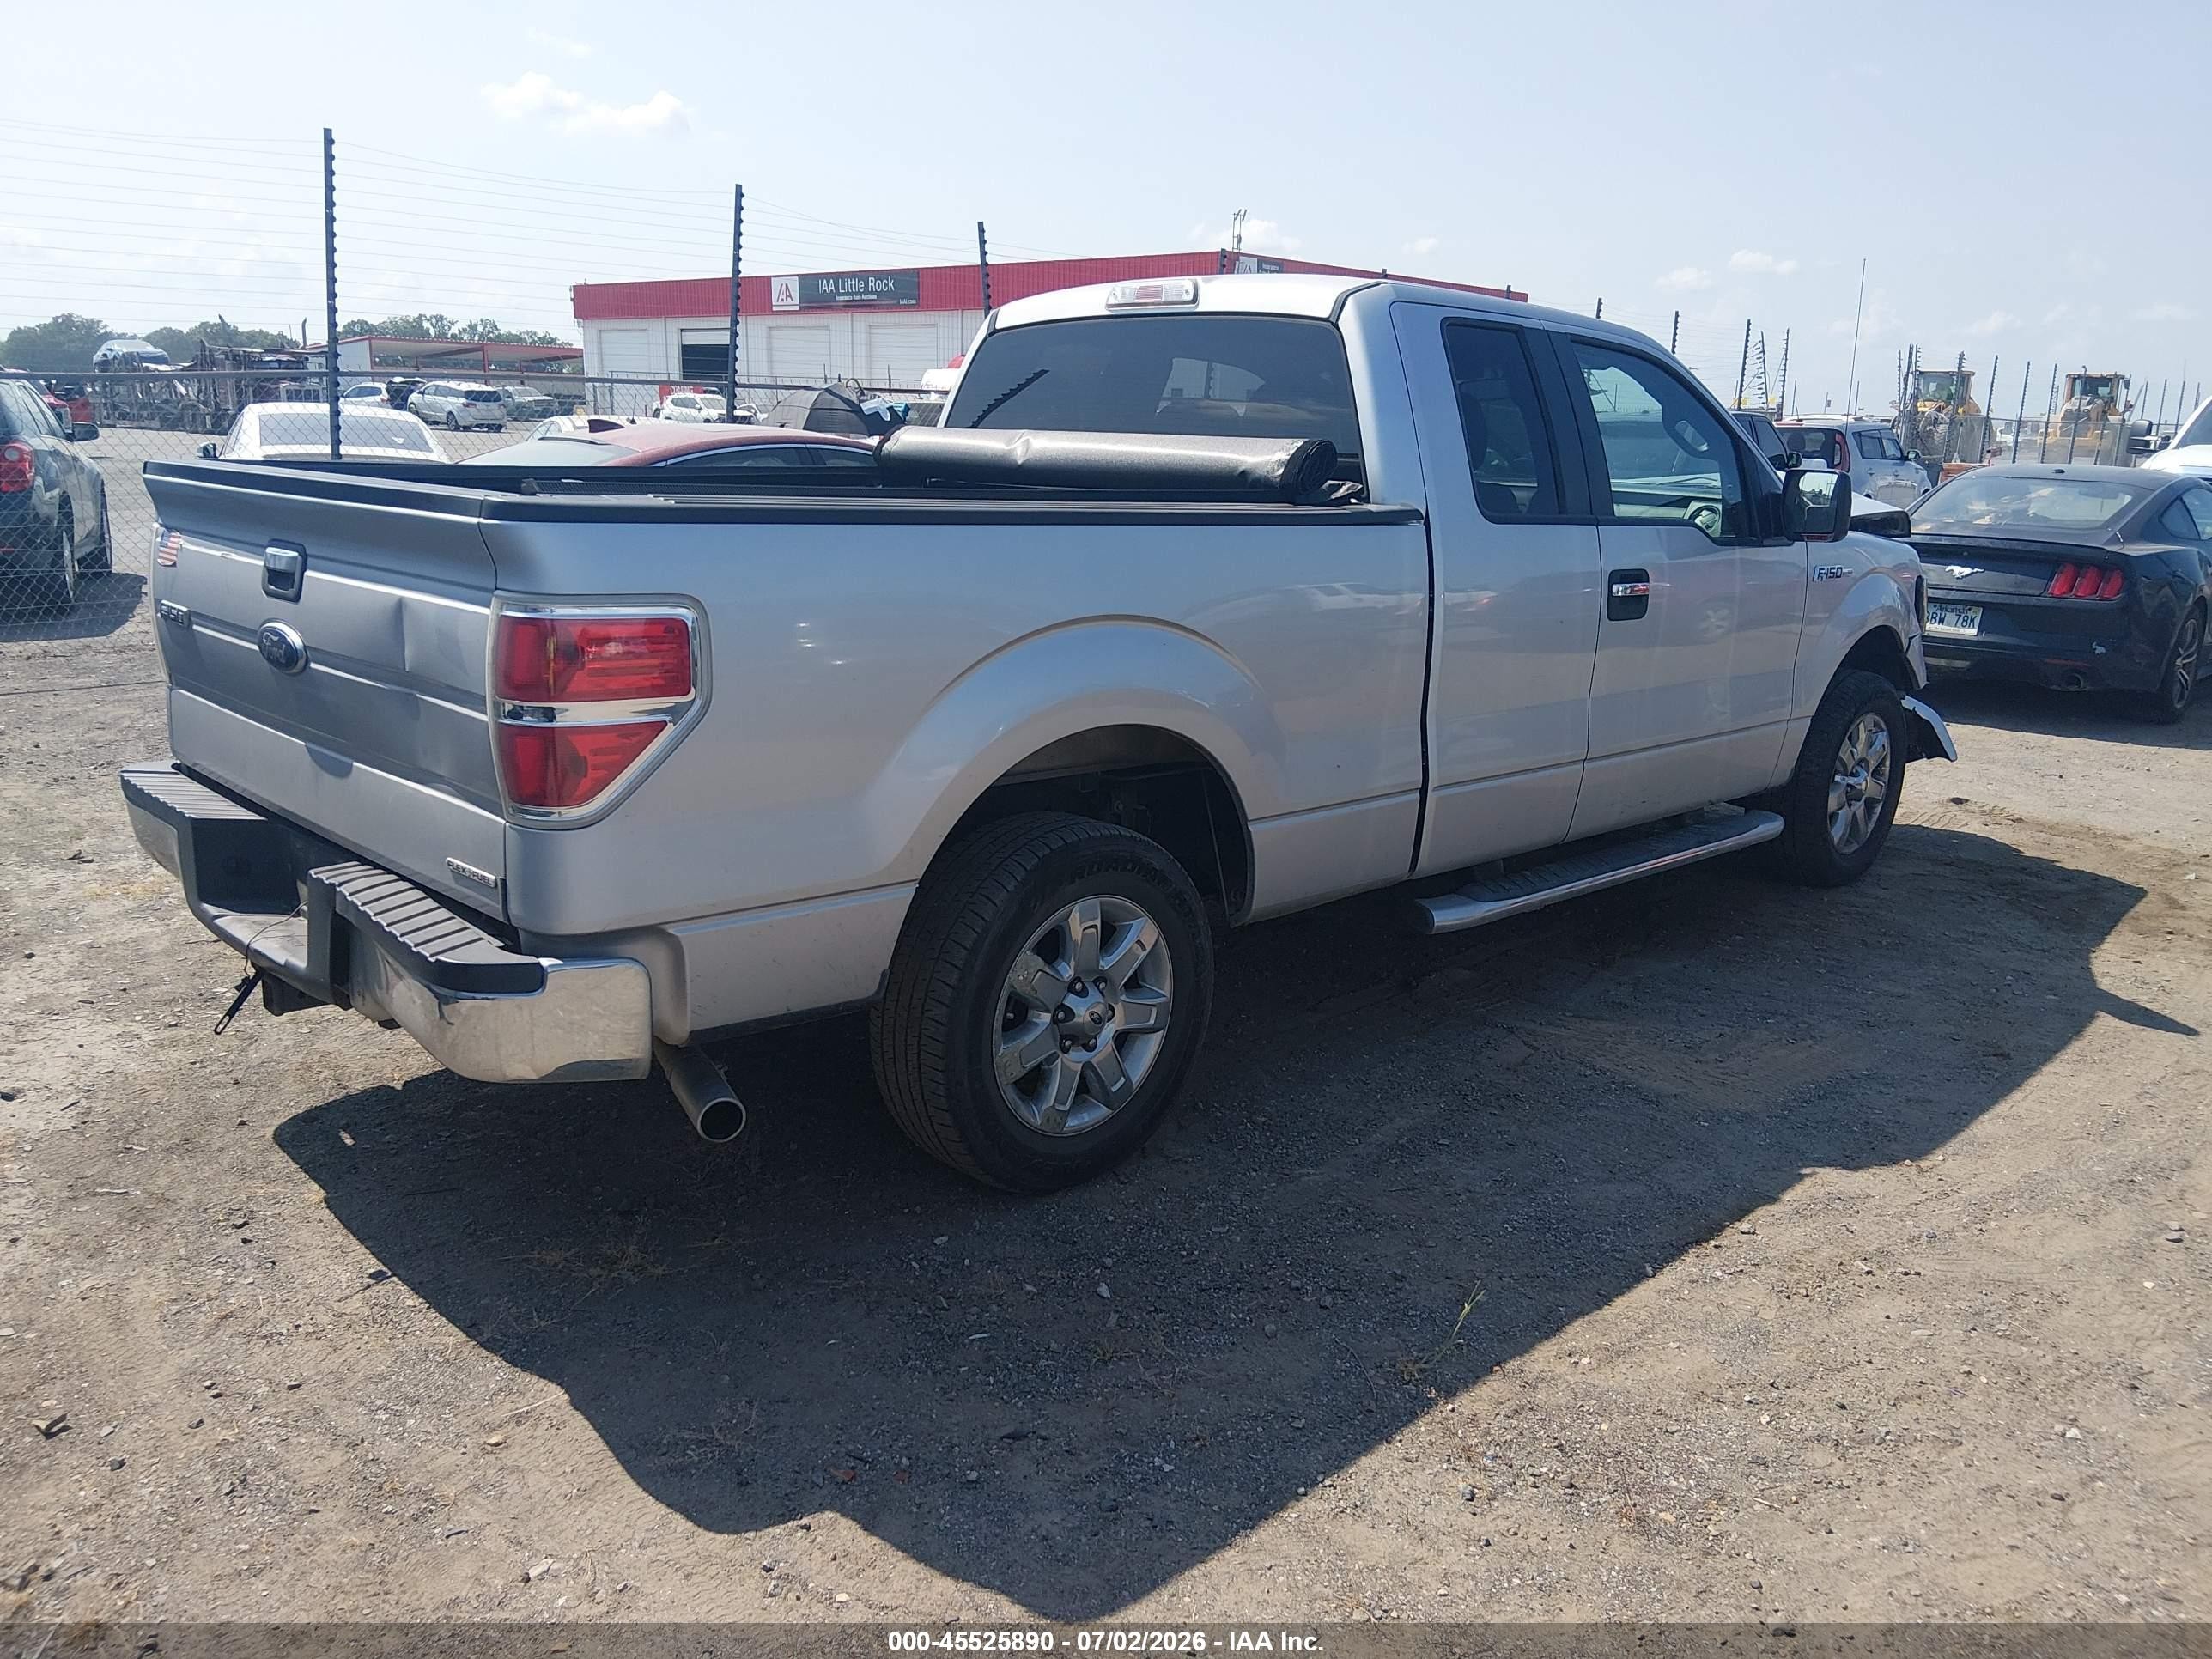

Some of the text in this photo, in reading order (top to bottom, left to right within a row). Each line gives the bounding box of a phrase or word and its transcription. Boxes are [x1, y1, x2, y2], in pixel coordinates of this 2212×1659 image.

[818, 276, 895, 294] IAA Little Rock
[1954, 614, 1978, 629] 78K
[262, 631, 287, 664] Ford
[447, 860, 494, 886] FLEX FUEL
